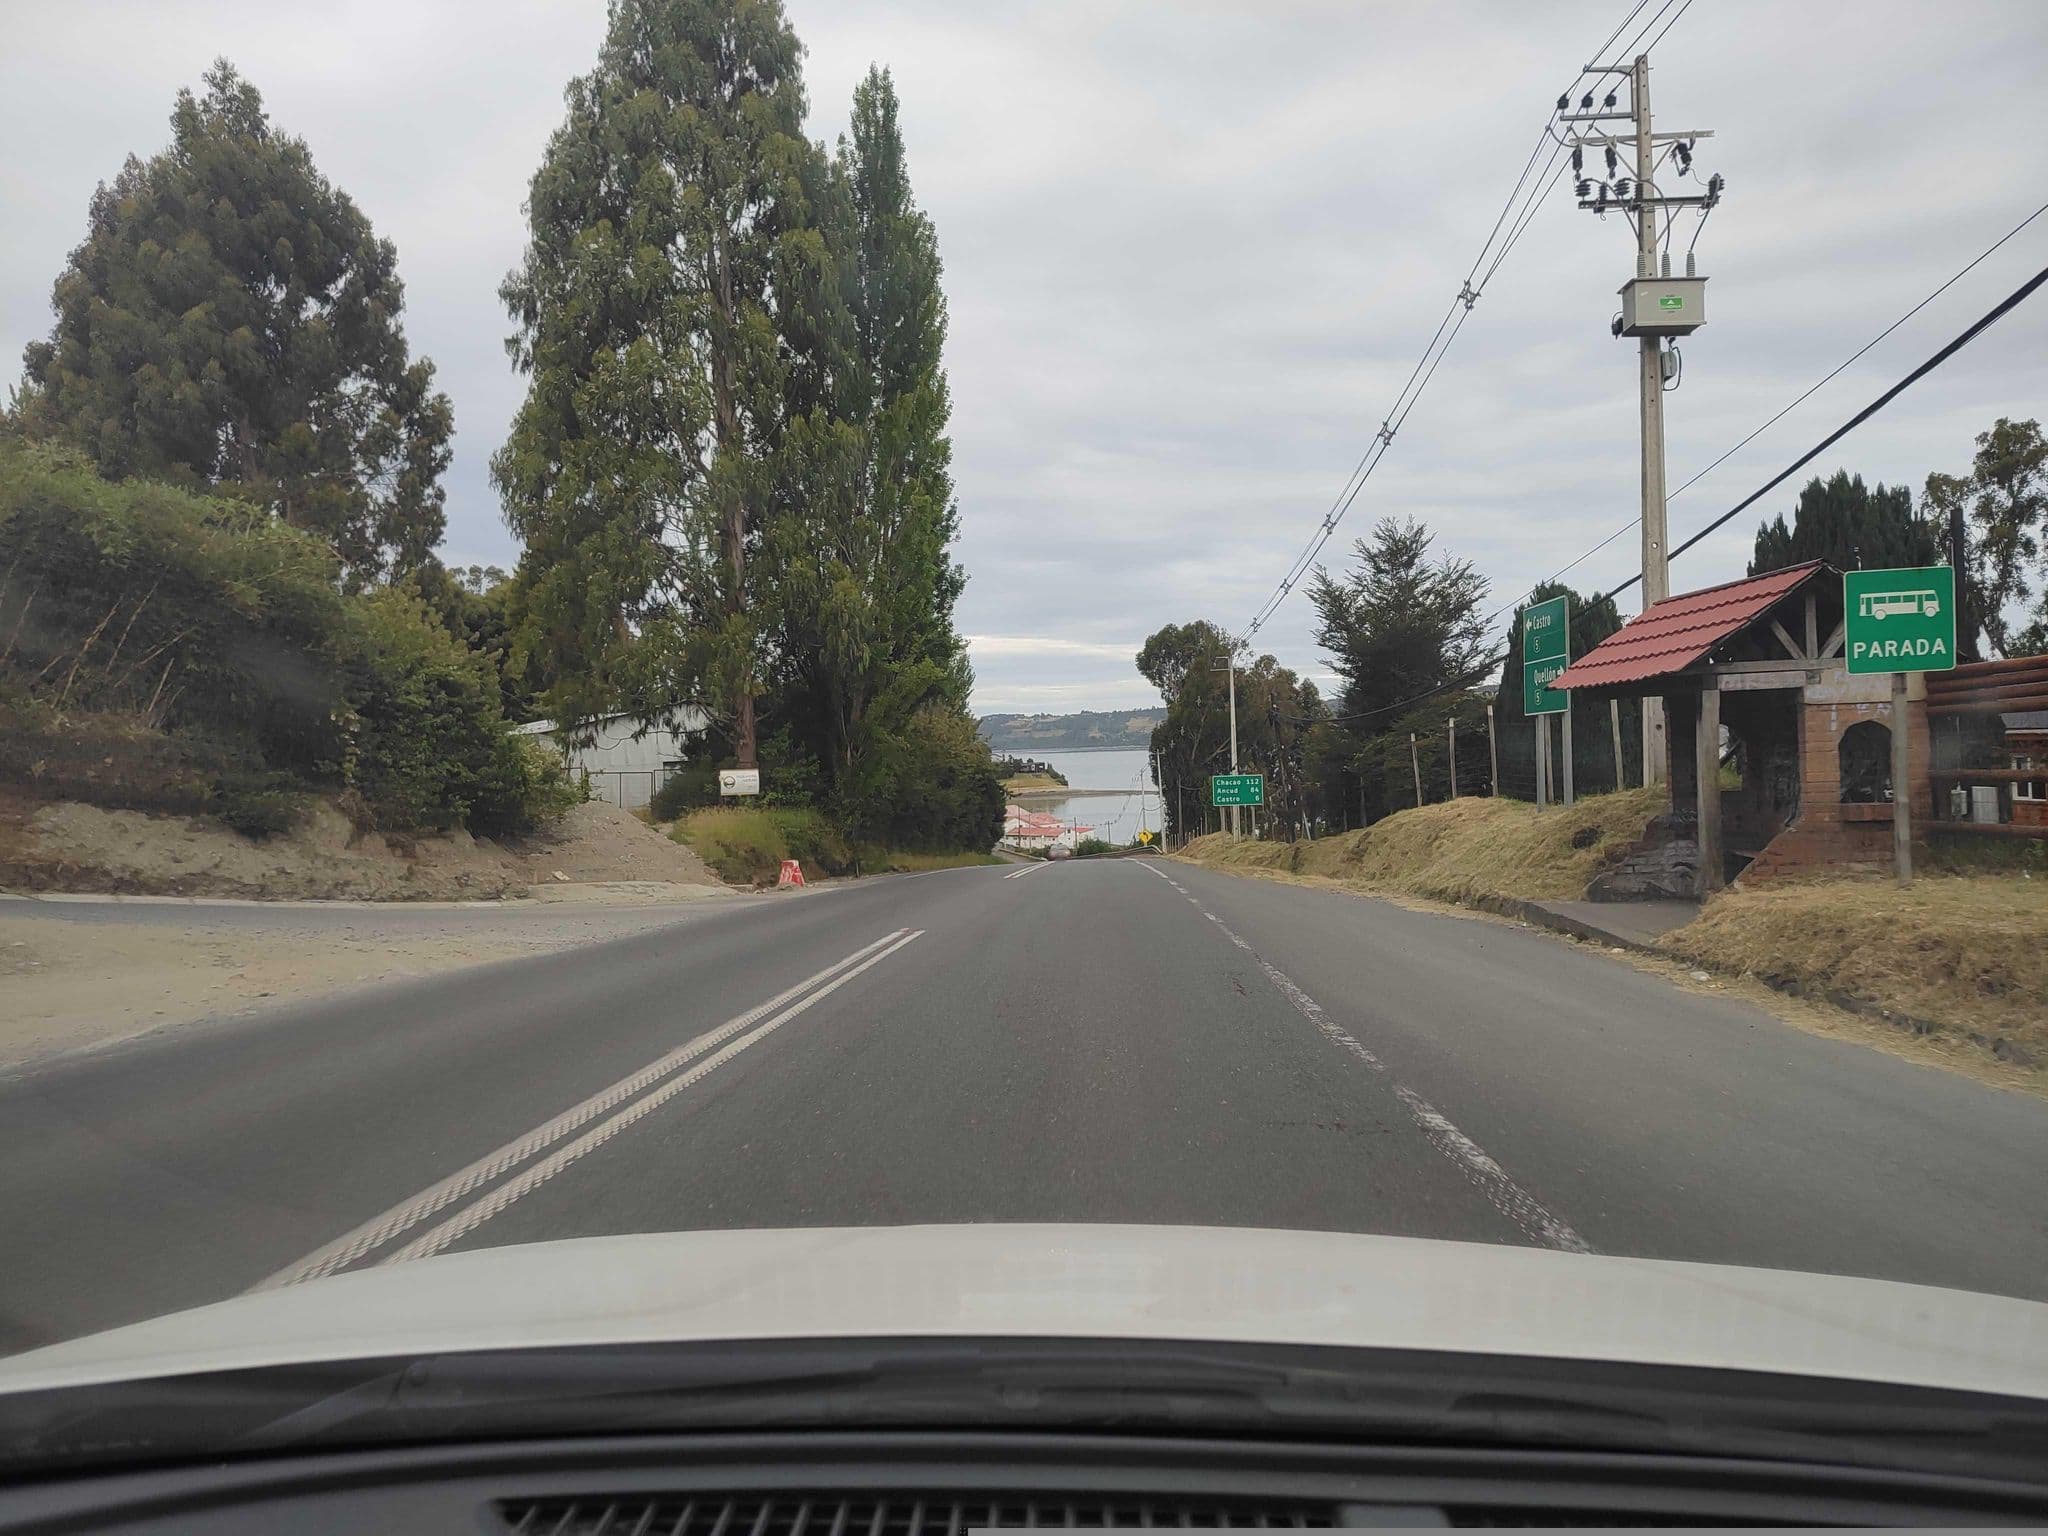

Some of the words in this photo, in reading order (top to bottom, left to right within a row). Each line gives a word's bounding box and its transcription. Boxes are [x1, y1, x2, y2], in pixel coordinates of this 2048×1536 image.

[1533, 615, 1551, 630] Castro
[1853, 638, 1947, 659] PARADA
[1534, 666, 1557, 686] Quellón
